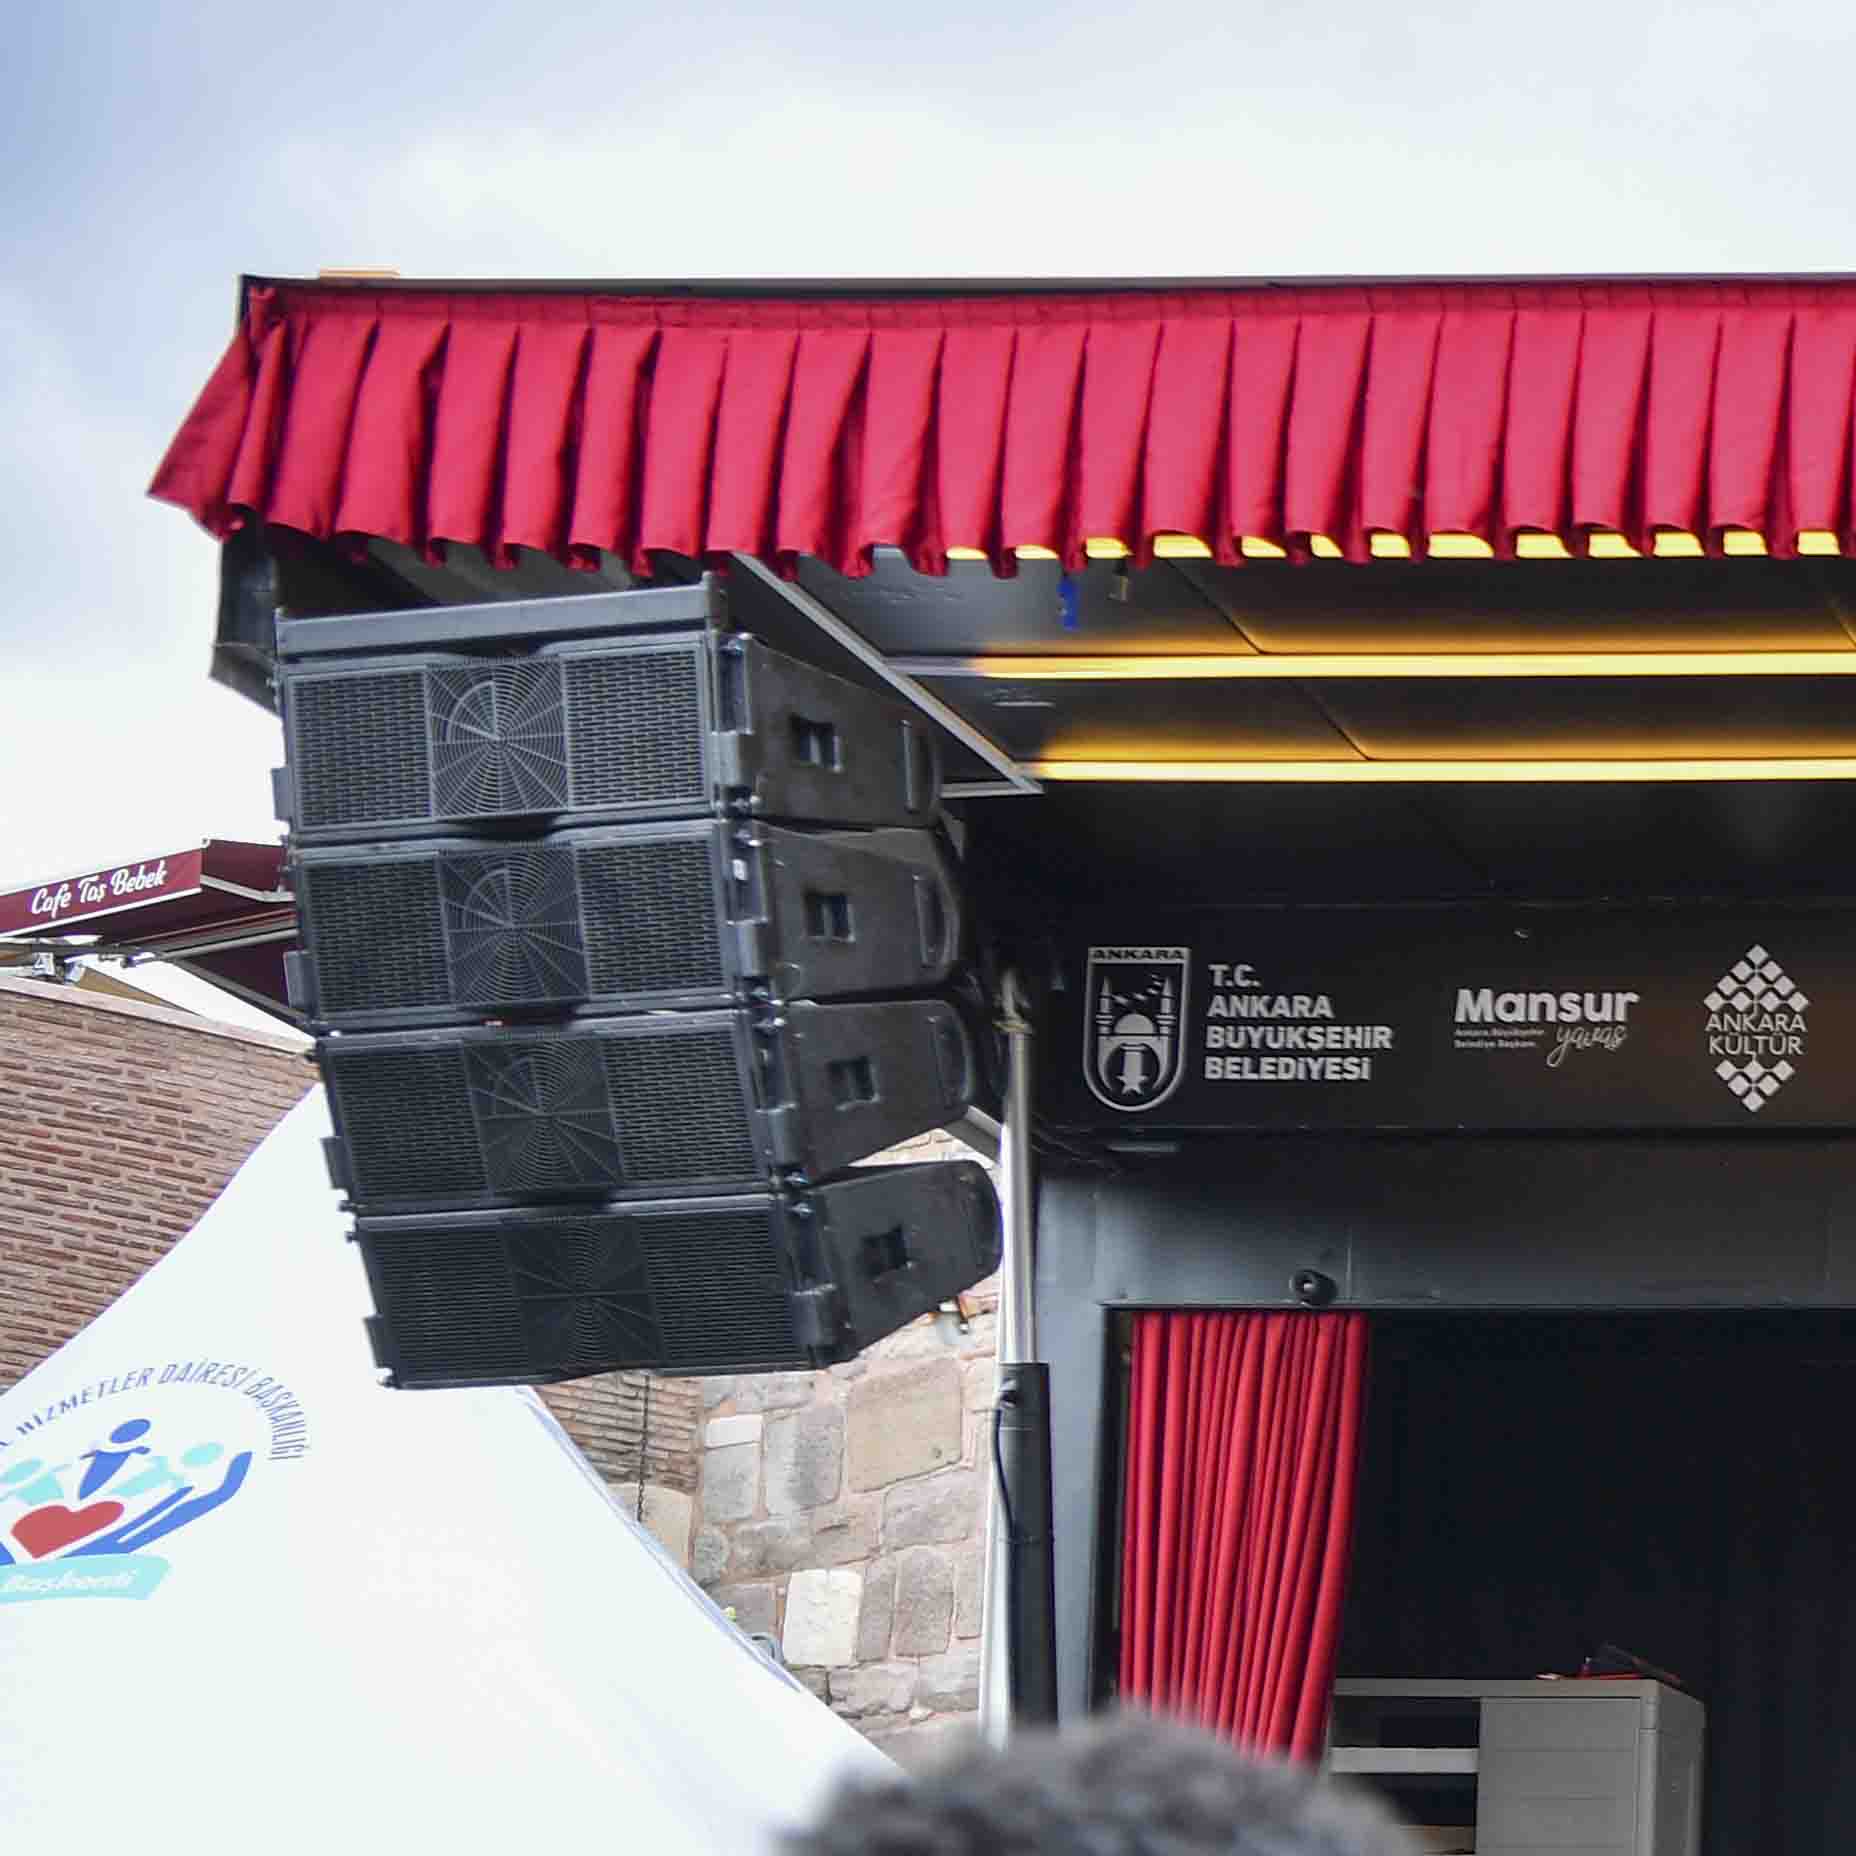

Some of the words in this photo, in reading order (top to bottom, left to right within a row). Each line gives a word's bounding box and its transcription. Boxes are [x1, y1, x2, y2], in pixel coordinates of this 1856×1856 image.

[31, 883, 72, 918] Cafe
[110, 859, 168, 896] Bebek
[1092, 949, 1185, 961] ANKARA
[1208, 963, 1261, 988] T.C.
[1206, 994, 1335, 1019] ANKARA
[1454, 988, 1641, 1023] Mansur
[1704, 1013, 1808, 1033] ANKARA
[1709, 1032, 1804, 1056] KÜLTÜR
[1203, 1055, 1373, 1081] BELEDİYESİ
